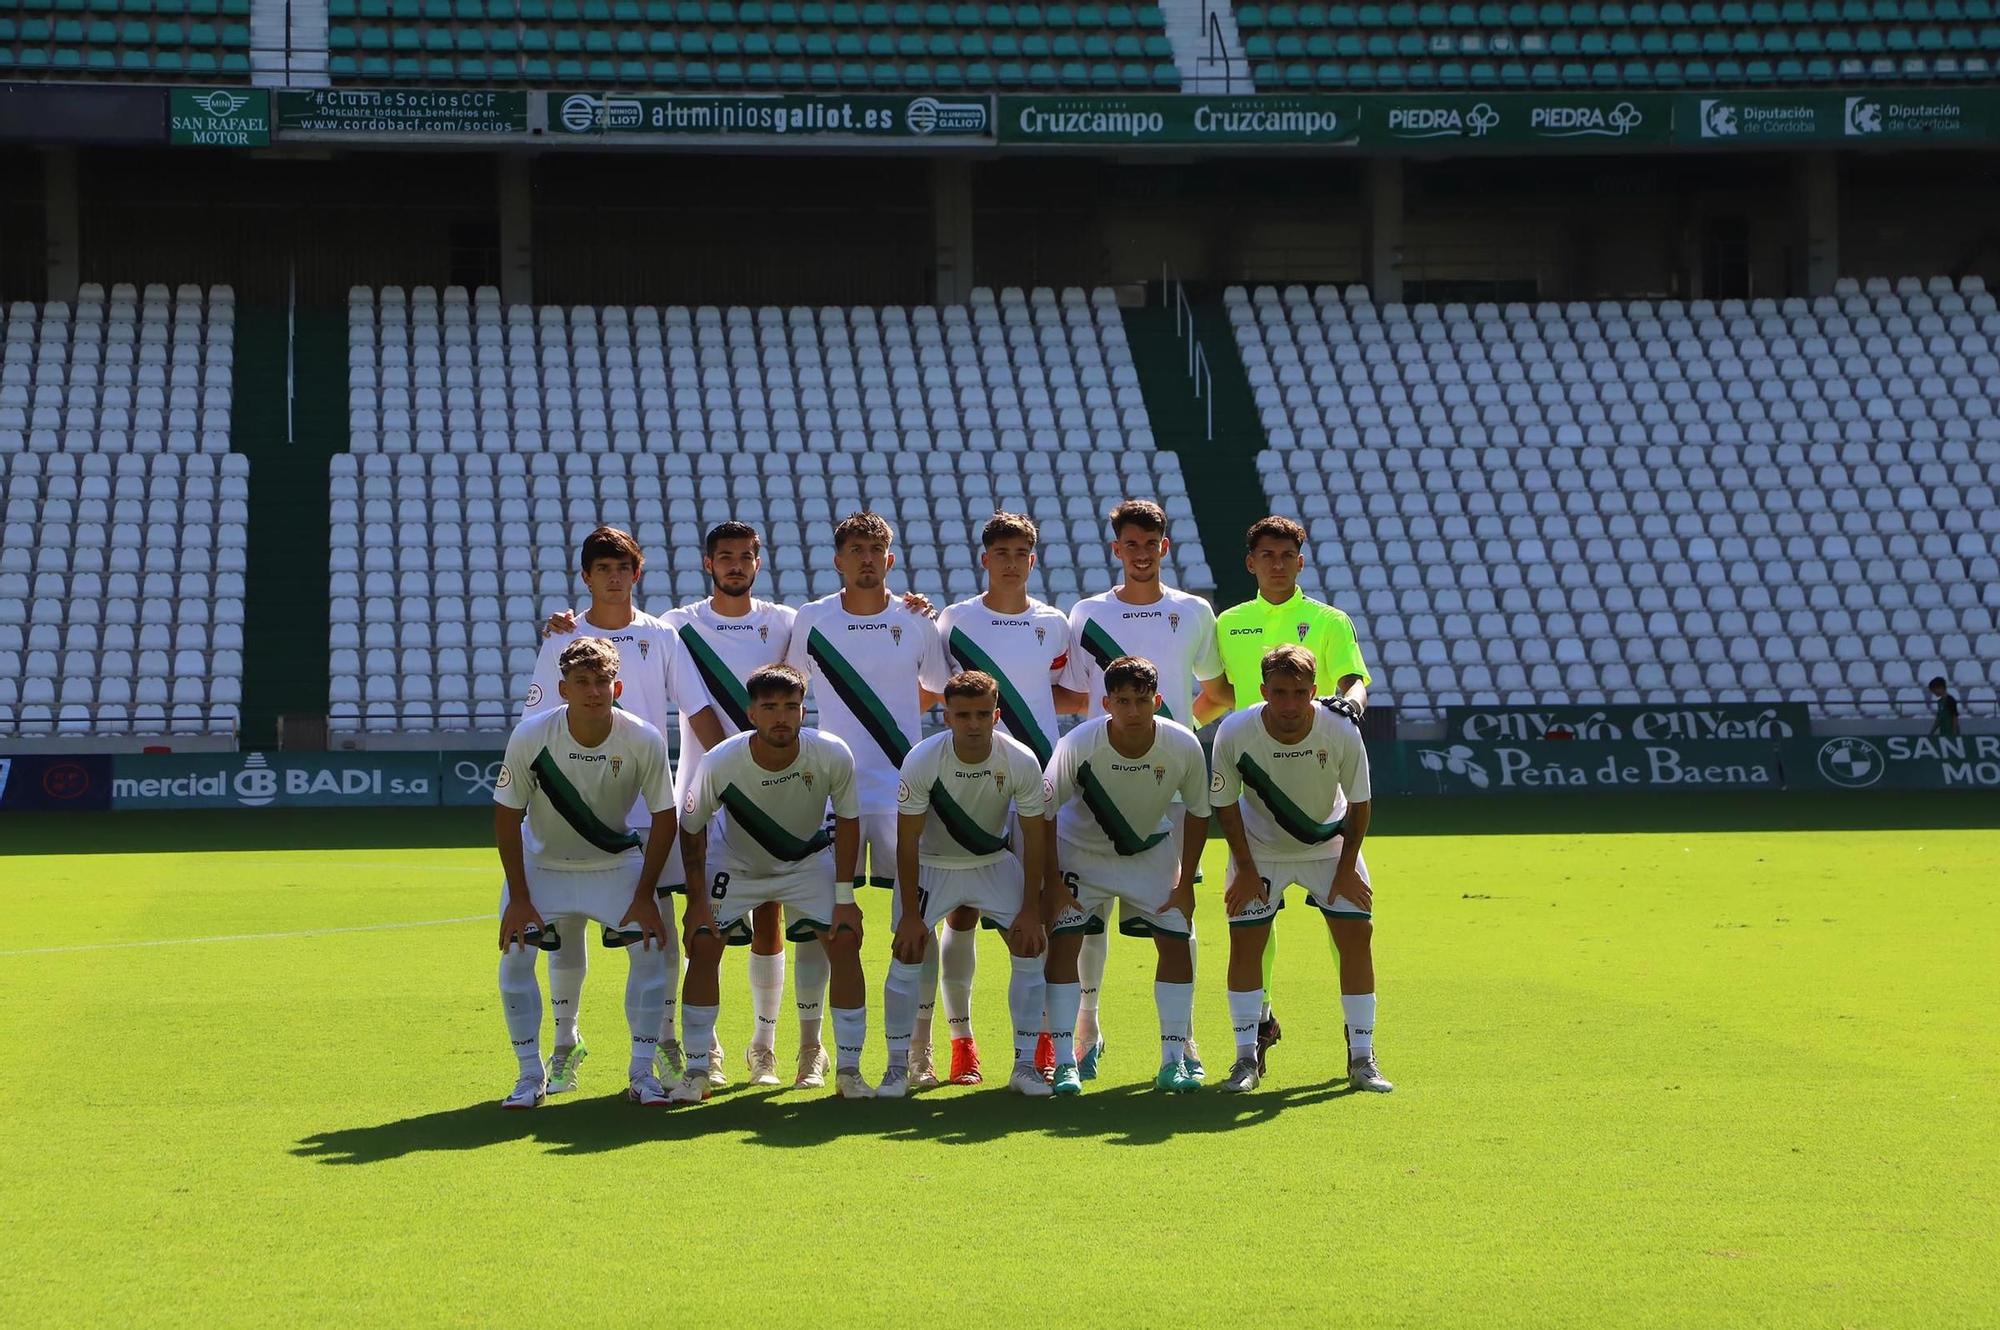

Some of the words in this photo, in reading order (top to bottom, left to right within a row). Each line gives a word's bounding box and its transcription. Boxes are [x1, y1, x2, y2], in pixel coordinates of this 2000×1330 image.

[211, 99, 231, 108] MINI
[652, 101, 893, 133] aluminiosgaliot.es
[1744, 106, 1815, 122] Diputación
[1889, 104, 1961, 120] Diputación
[172, 116, 203, 130] SAN
[208, 117, 268, 131] RAFAEL
[301, 118, 512, 132] www.cordobacf.com/socios
[938, 119, 981, 128] GALIOT
[1019, 105, 1164, 136] Cruzcampo
[1194, 104, 1337, 136] Cruzcampo
[192, 131, 250, 145] MOTOR
[1122, 611, 1162, 619] GIVOVA
[848, 623, 888, 631] GIVOVA
[1273, 749, 1313, 760] GIVOVA
[1824, 739, 1874, 755] BMW
[1887, 736, 1966, 760] SAN
[568, 752, 607, 762] GIVOVA
[955, 769, 992, 779] GIVOVA
[1111, 763, 1151, 772] GIVOVA
[1493, 747, 1589, 787] Peña
[1597, 755, 1641, 785] de
[1645, 747, 1770, 784] Baena
[112, 770, 227, 798] mercial
[286, 769, 383, 795] BADI
[391, 778, 430, 794] s.a
[761, 771, 801, 787] GIVOVA
[711, 871, 731, 900] 8
[1240, 905, 1272, 917] GIVOVA
